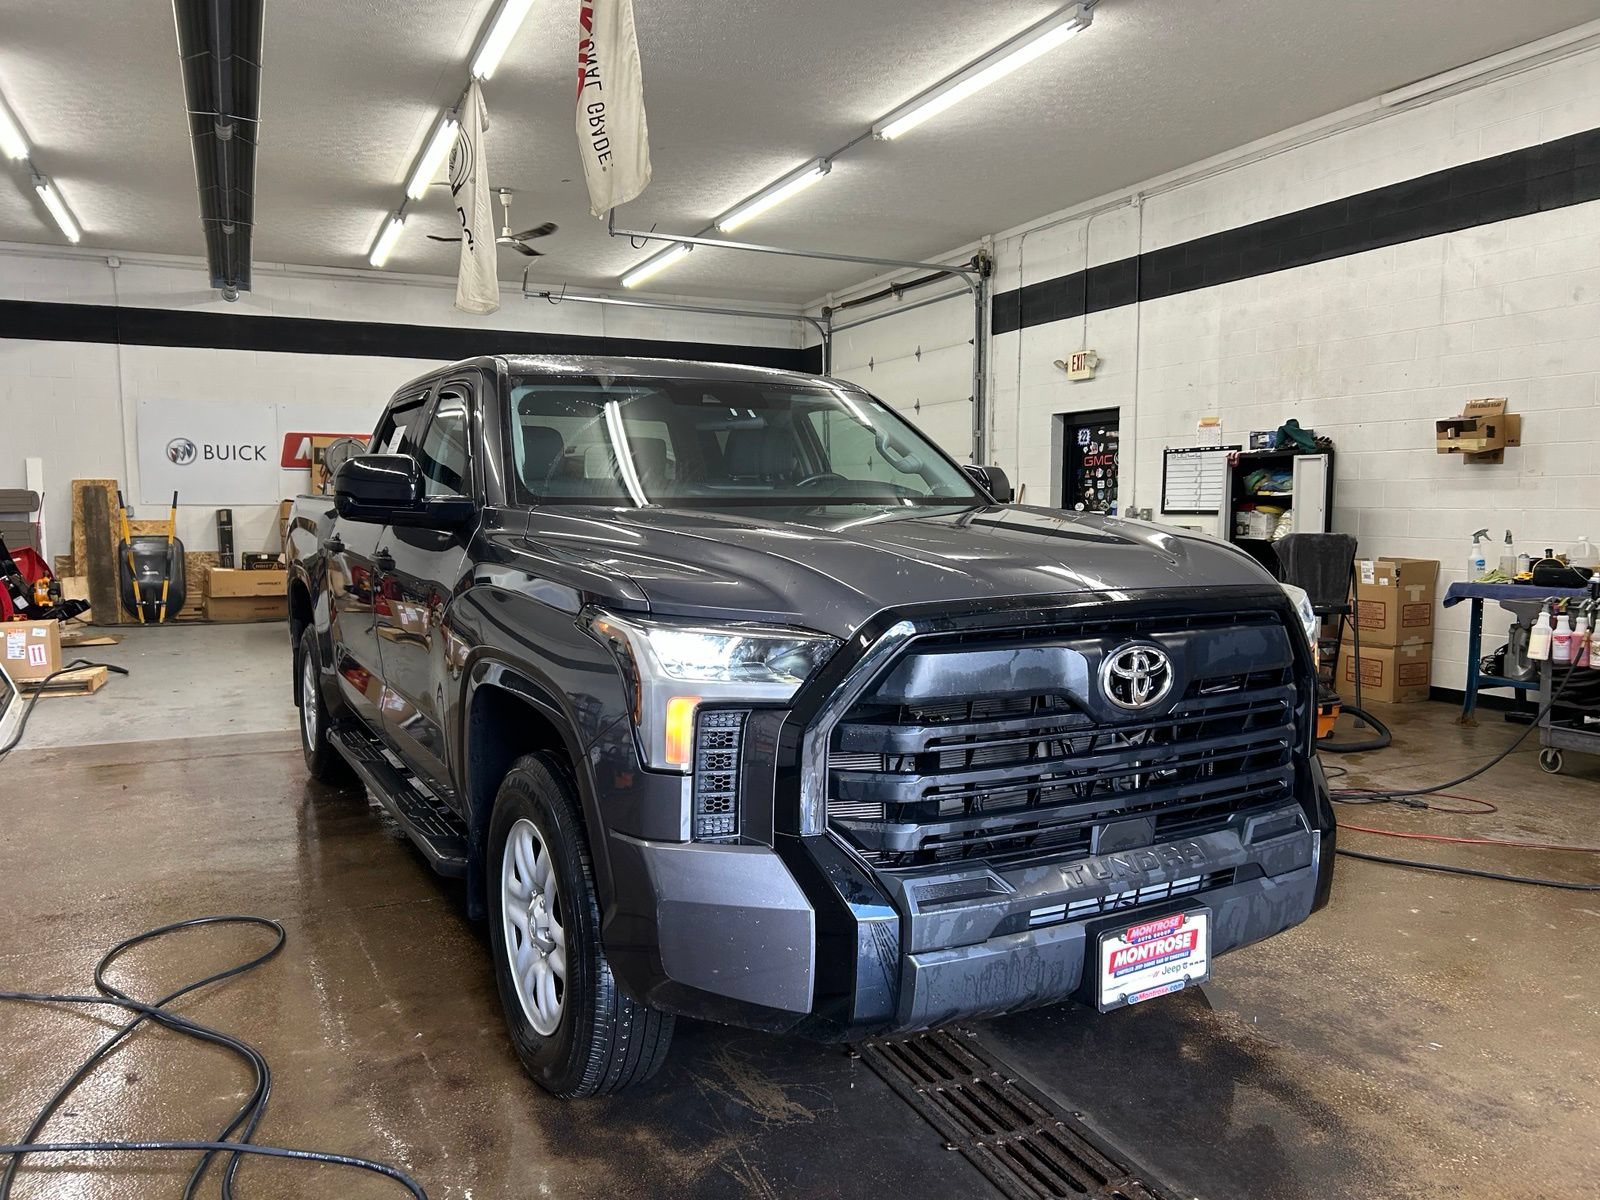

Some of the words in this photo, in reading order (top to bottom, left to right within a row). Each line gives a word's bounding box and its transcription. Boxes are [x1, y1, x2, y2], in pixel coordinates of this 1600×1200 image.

[1072, 353, 1086, 372] EXIT
[204, 445, 267, 461] BUICK
[1084, 455, 1113, 467] GMC
[1060, 842, 1207, 885] TUNDRA
[1130, 916, 1180, 938] MONTROSE
[1113, 933, 1191, 968] MONTROSE
[1161, 964, 1181, 975] Jeep
[1129, 982, 1184, 1003] GoMontrose.com
